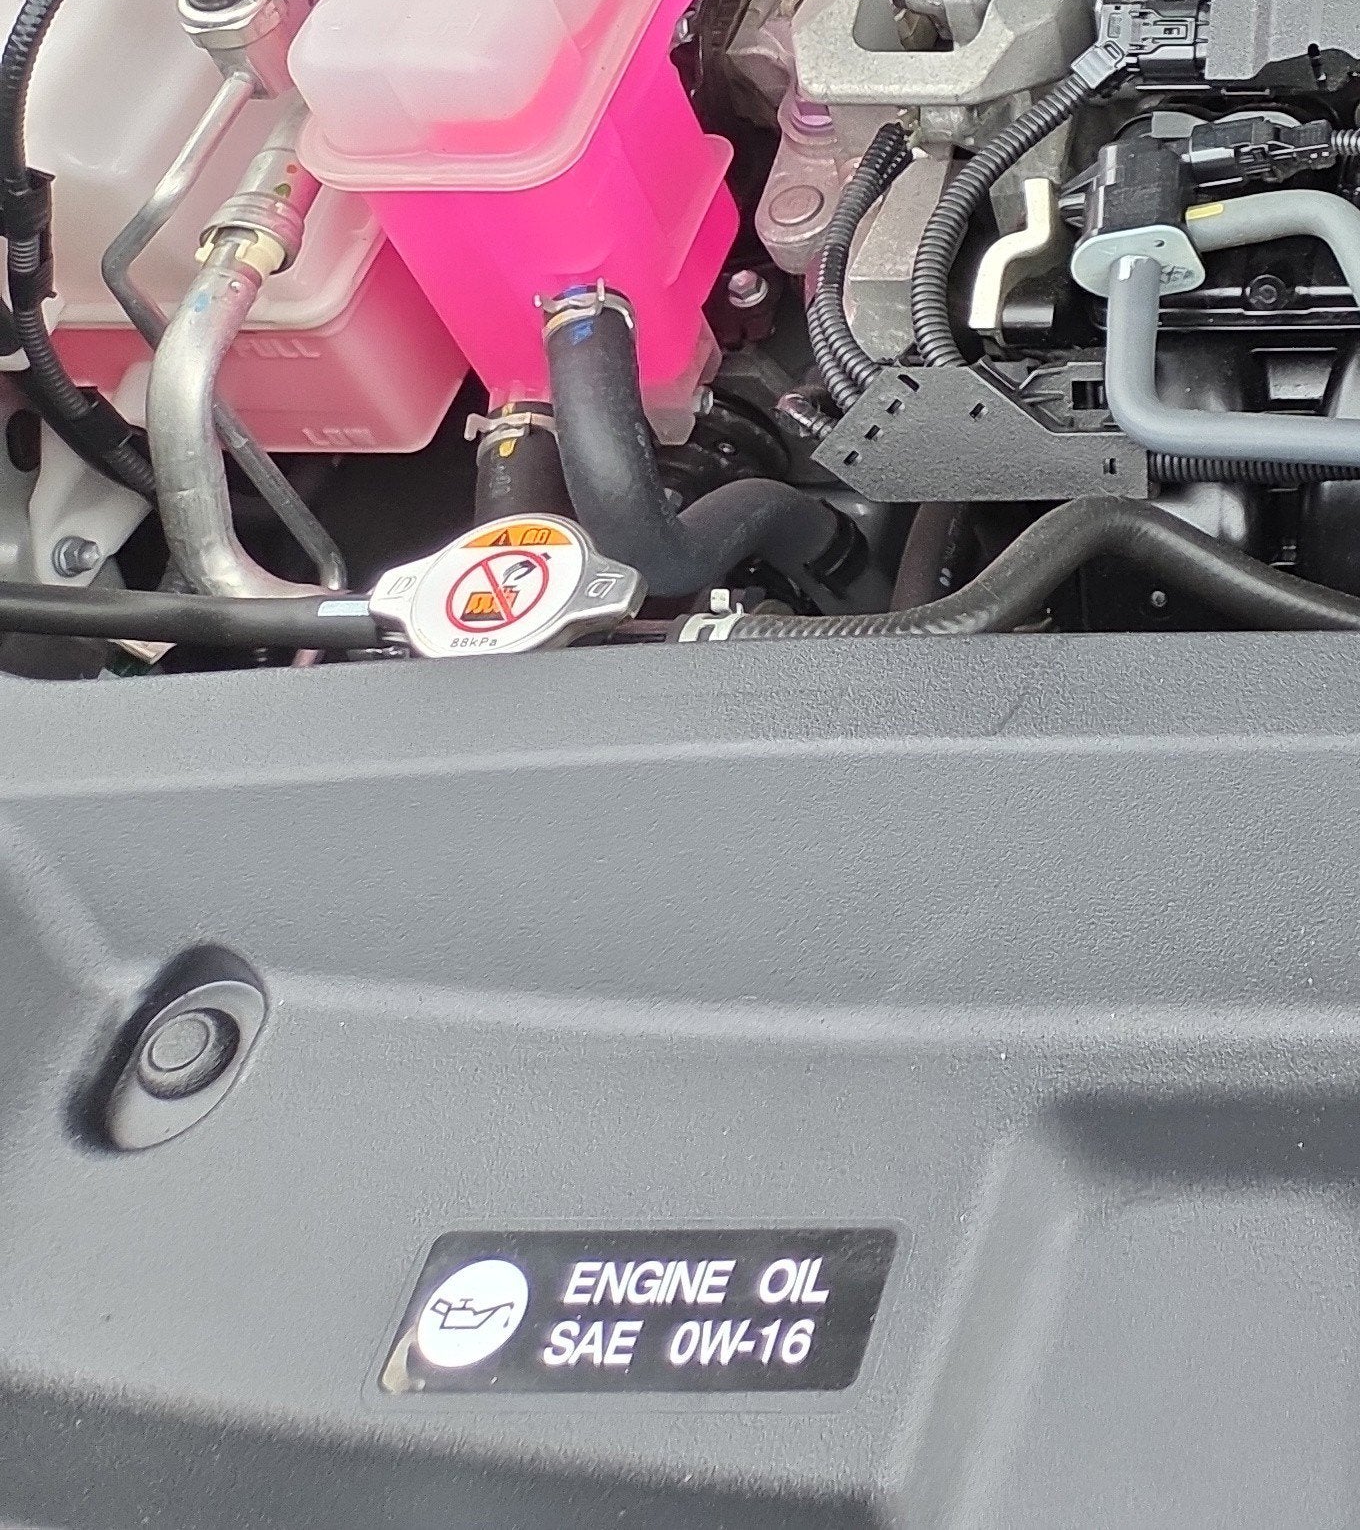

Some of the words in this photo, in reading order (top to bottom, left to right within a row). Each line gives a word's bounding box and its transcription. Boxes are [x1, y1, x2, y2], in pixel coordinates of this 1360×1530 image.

[450, 637, 498, 648] 88kPa
[563, 1259, 737, 1305] ENGINE
[758, 1257, 831, 1305] OIL
[542, 1319, 645, 1367] SAE
[668, 1318, 816, 1367] 0W-16
